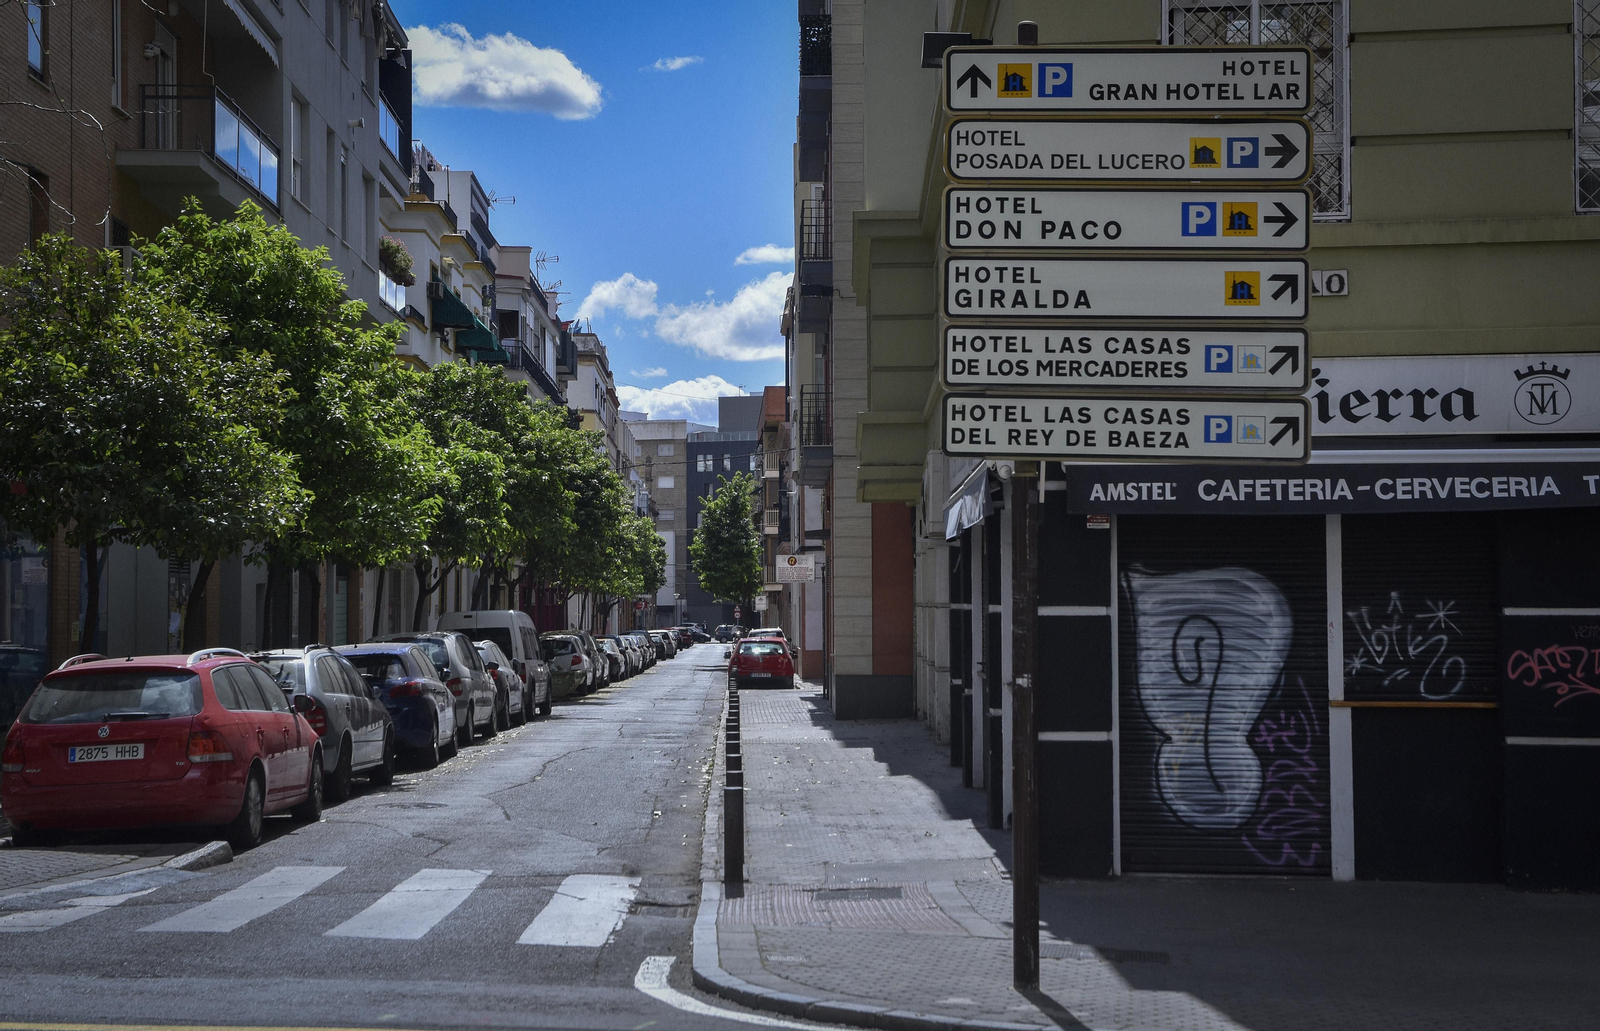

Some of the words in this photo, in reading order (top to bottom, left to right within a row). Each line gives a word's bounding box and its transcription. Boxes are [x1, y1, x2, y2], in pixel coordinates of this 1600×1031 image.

[1223, 60, 1300, 76] HOTEL
[1045, 66, 1067, 94] P
[1089, 83, 1158, 101] GRAN
[1166, 83, 1245, 101] HOTEL
[1254, 83, 1300, 101] LAR
[956, 130, 1026, 147] HOTEL
[956, 153, 1044, 170] POSADA
[1051, 153, 1091, 170] DEL
[1099, 153, 1186, 170] LUCERO
[1233, 141, 1253, 164] P
[956, 197, 1043, 214] HOTEL
[1189, 205, 1211, 233] P
[956, 220, 1022, 240] DON
[1041, 220, 1123, 241] PACO
[955, 266, 1042, 284] HOTEL
[955, 289, 1092, 309] GIRALDA
[952, 335, 1033, 354] HOTEL
[1045, 337, 1092, 354] LAS
[1104, 337, 1191, 355] CASAS
[952, 359, 980, 376] DE
[987, 359, 1029, 377] LOS
[1036, 360, 1188, 379] MERCADERES
[1210, 348, 1229, 371] P
[1312, 368, 1480, 424] ierra
[951, 404, 1033, 423] HOTEL
[1044, 406, 1092, 424] LAS
[1104, 407, 1191, 426] CASAS
[951, 427, 997, 445] DEL
[1007, 428, 1055, 447] REY
[1066, 430, 1097, 447] DE
[1108, 430, 1190, 449] BAEZA
[1210, 418, 1228, 441] P
[78, 747, 109, 761] 2875
[115, 745, 140, 759] HHB
